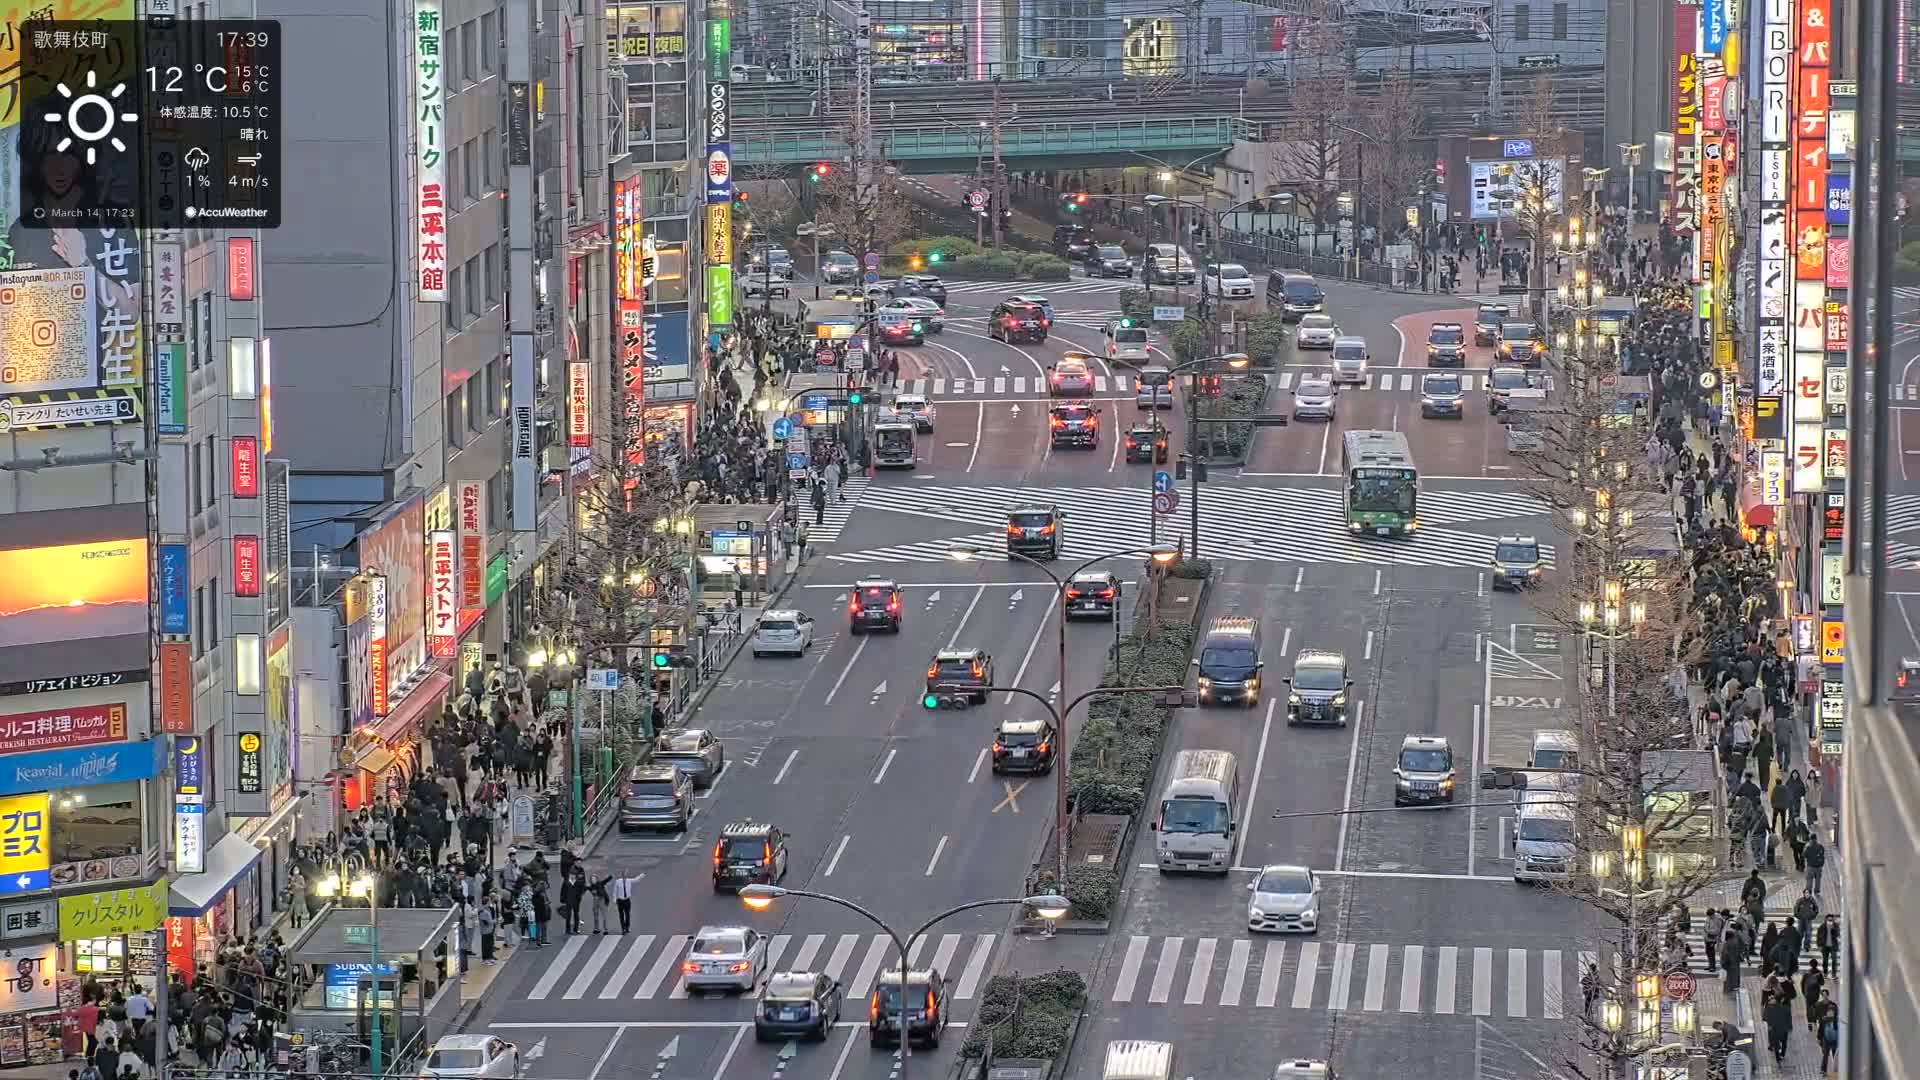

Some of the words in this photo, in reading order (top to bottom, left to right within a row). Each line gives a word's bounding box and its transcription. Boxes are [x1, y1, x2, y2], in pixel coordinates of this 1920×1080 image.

[418, 10, 442, 169] 新宿サンパーク
[711, 160, 727, 176] 薬
[1771, 152, 1779, 199] ESOLA
[1676, 146, 1695, 231] エスパス
[421, 183, 445, 291] 三平本館
[161, 323, 178, 333] 3F
[1762, 329, 1776, 381] 大衆酒場
[159, 352, 171, 414] FamilyMart
[1798, 307, 1822, 469] パセラ
[16, 409, 51, 421] テンクリ
[464, 486, 474, 530] GAME
[1831, 496, 1842, 505] 3F
[435, 541, 451, 628] 三平ストア
[28, 734, 71, 746] RESTAURANT
[2, 810, 42, 834] プロ
[3, 834, 42, 857] ミス
[8, 911, 41, 931] 囲碁
[72, 903, 144, 926] クリスタル
